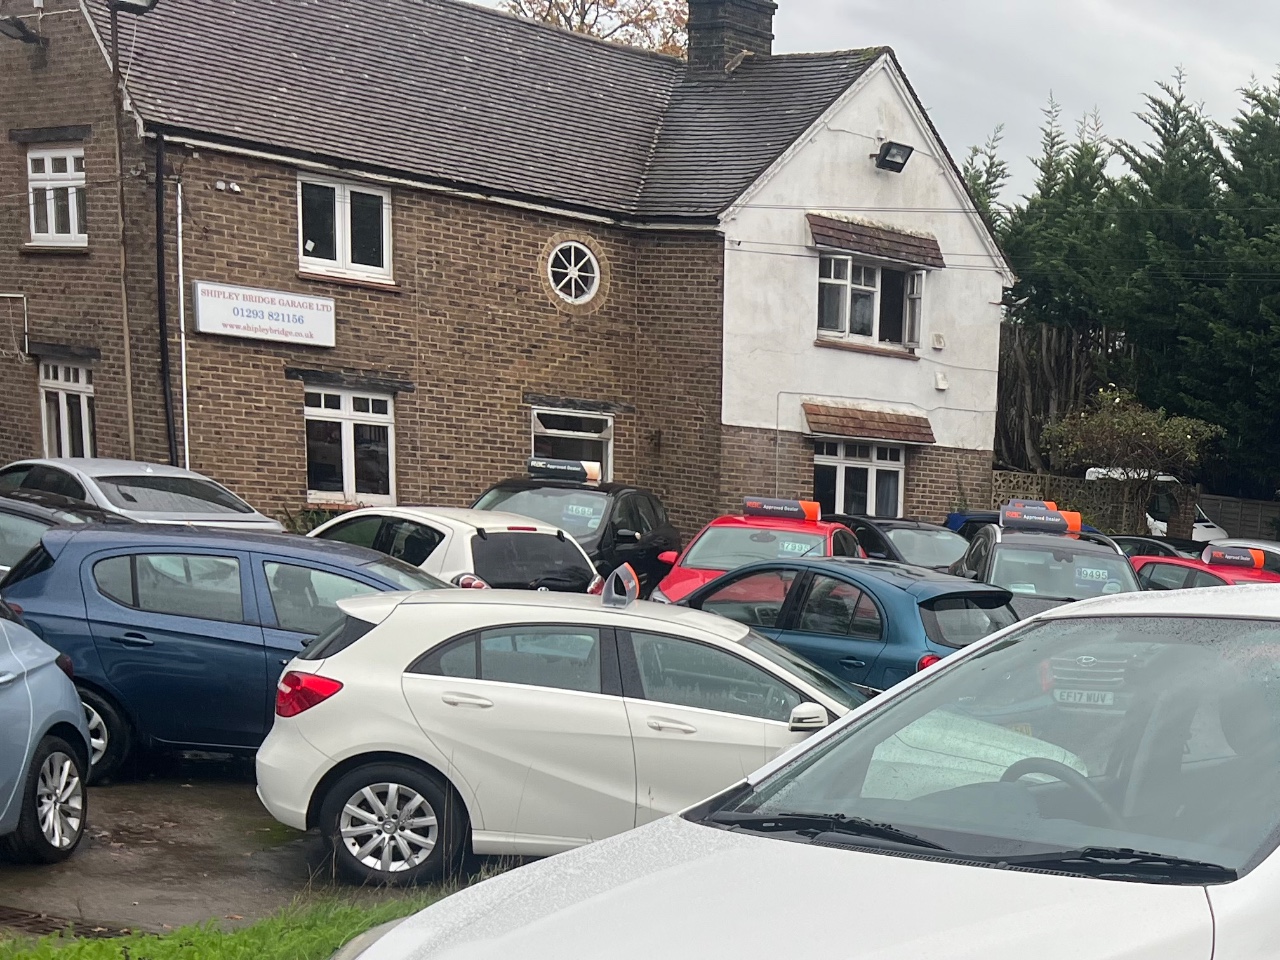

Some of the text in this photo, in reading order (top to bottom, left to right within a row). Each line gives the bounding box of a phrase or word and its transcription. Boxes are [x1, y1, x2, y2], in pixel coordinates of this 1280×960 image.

[200, 288, 333, 313] SHIPLEY BRIDGE GARAGE LTD
[232, 306, 305, 325] 01293 821156
[221, 321, 314, 339] www.shipleybridge.co.uk
